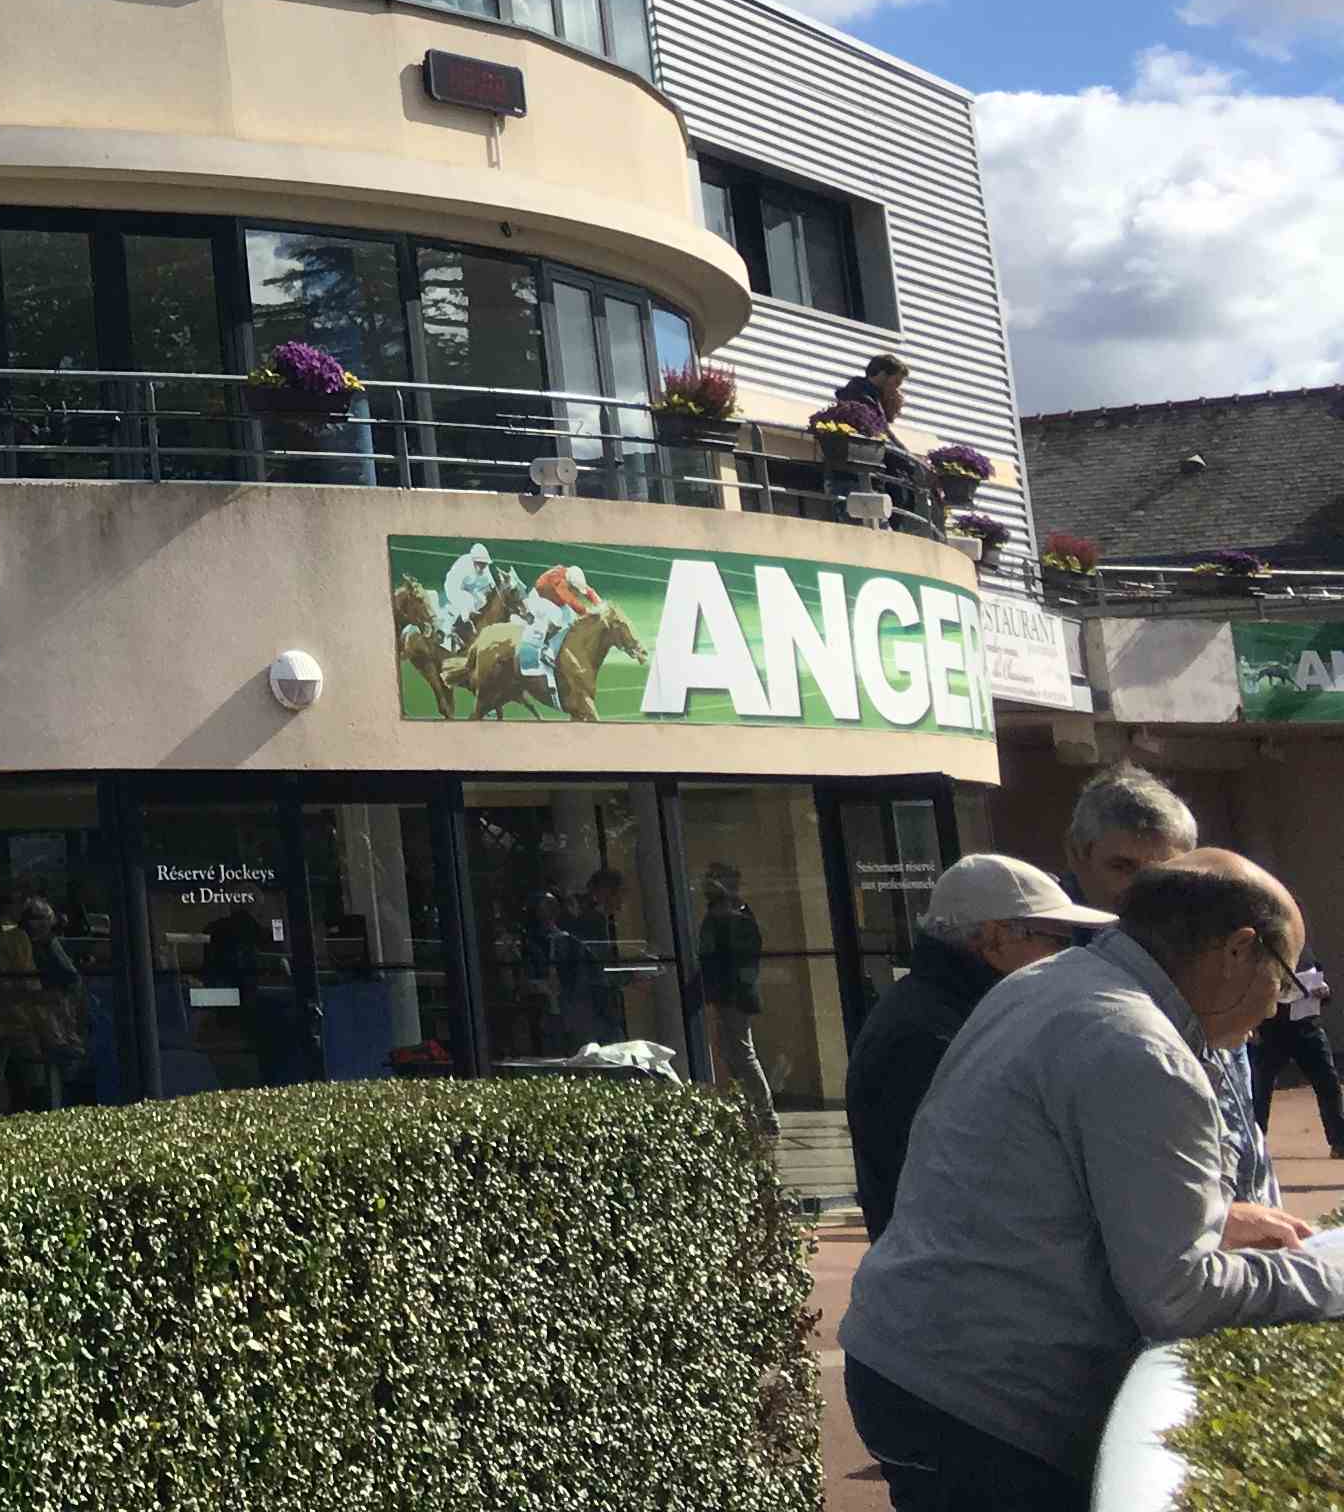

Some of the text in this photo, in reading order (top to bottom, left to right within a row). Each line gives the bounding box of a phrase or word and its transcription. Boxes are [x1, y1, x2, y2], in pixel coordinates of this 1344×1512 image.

[156, 863, 275, 884] Réservé Jockeys
[180, 888, 256, 904] et Drivers
